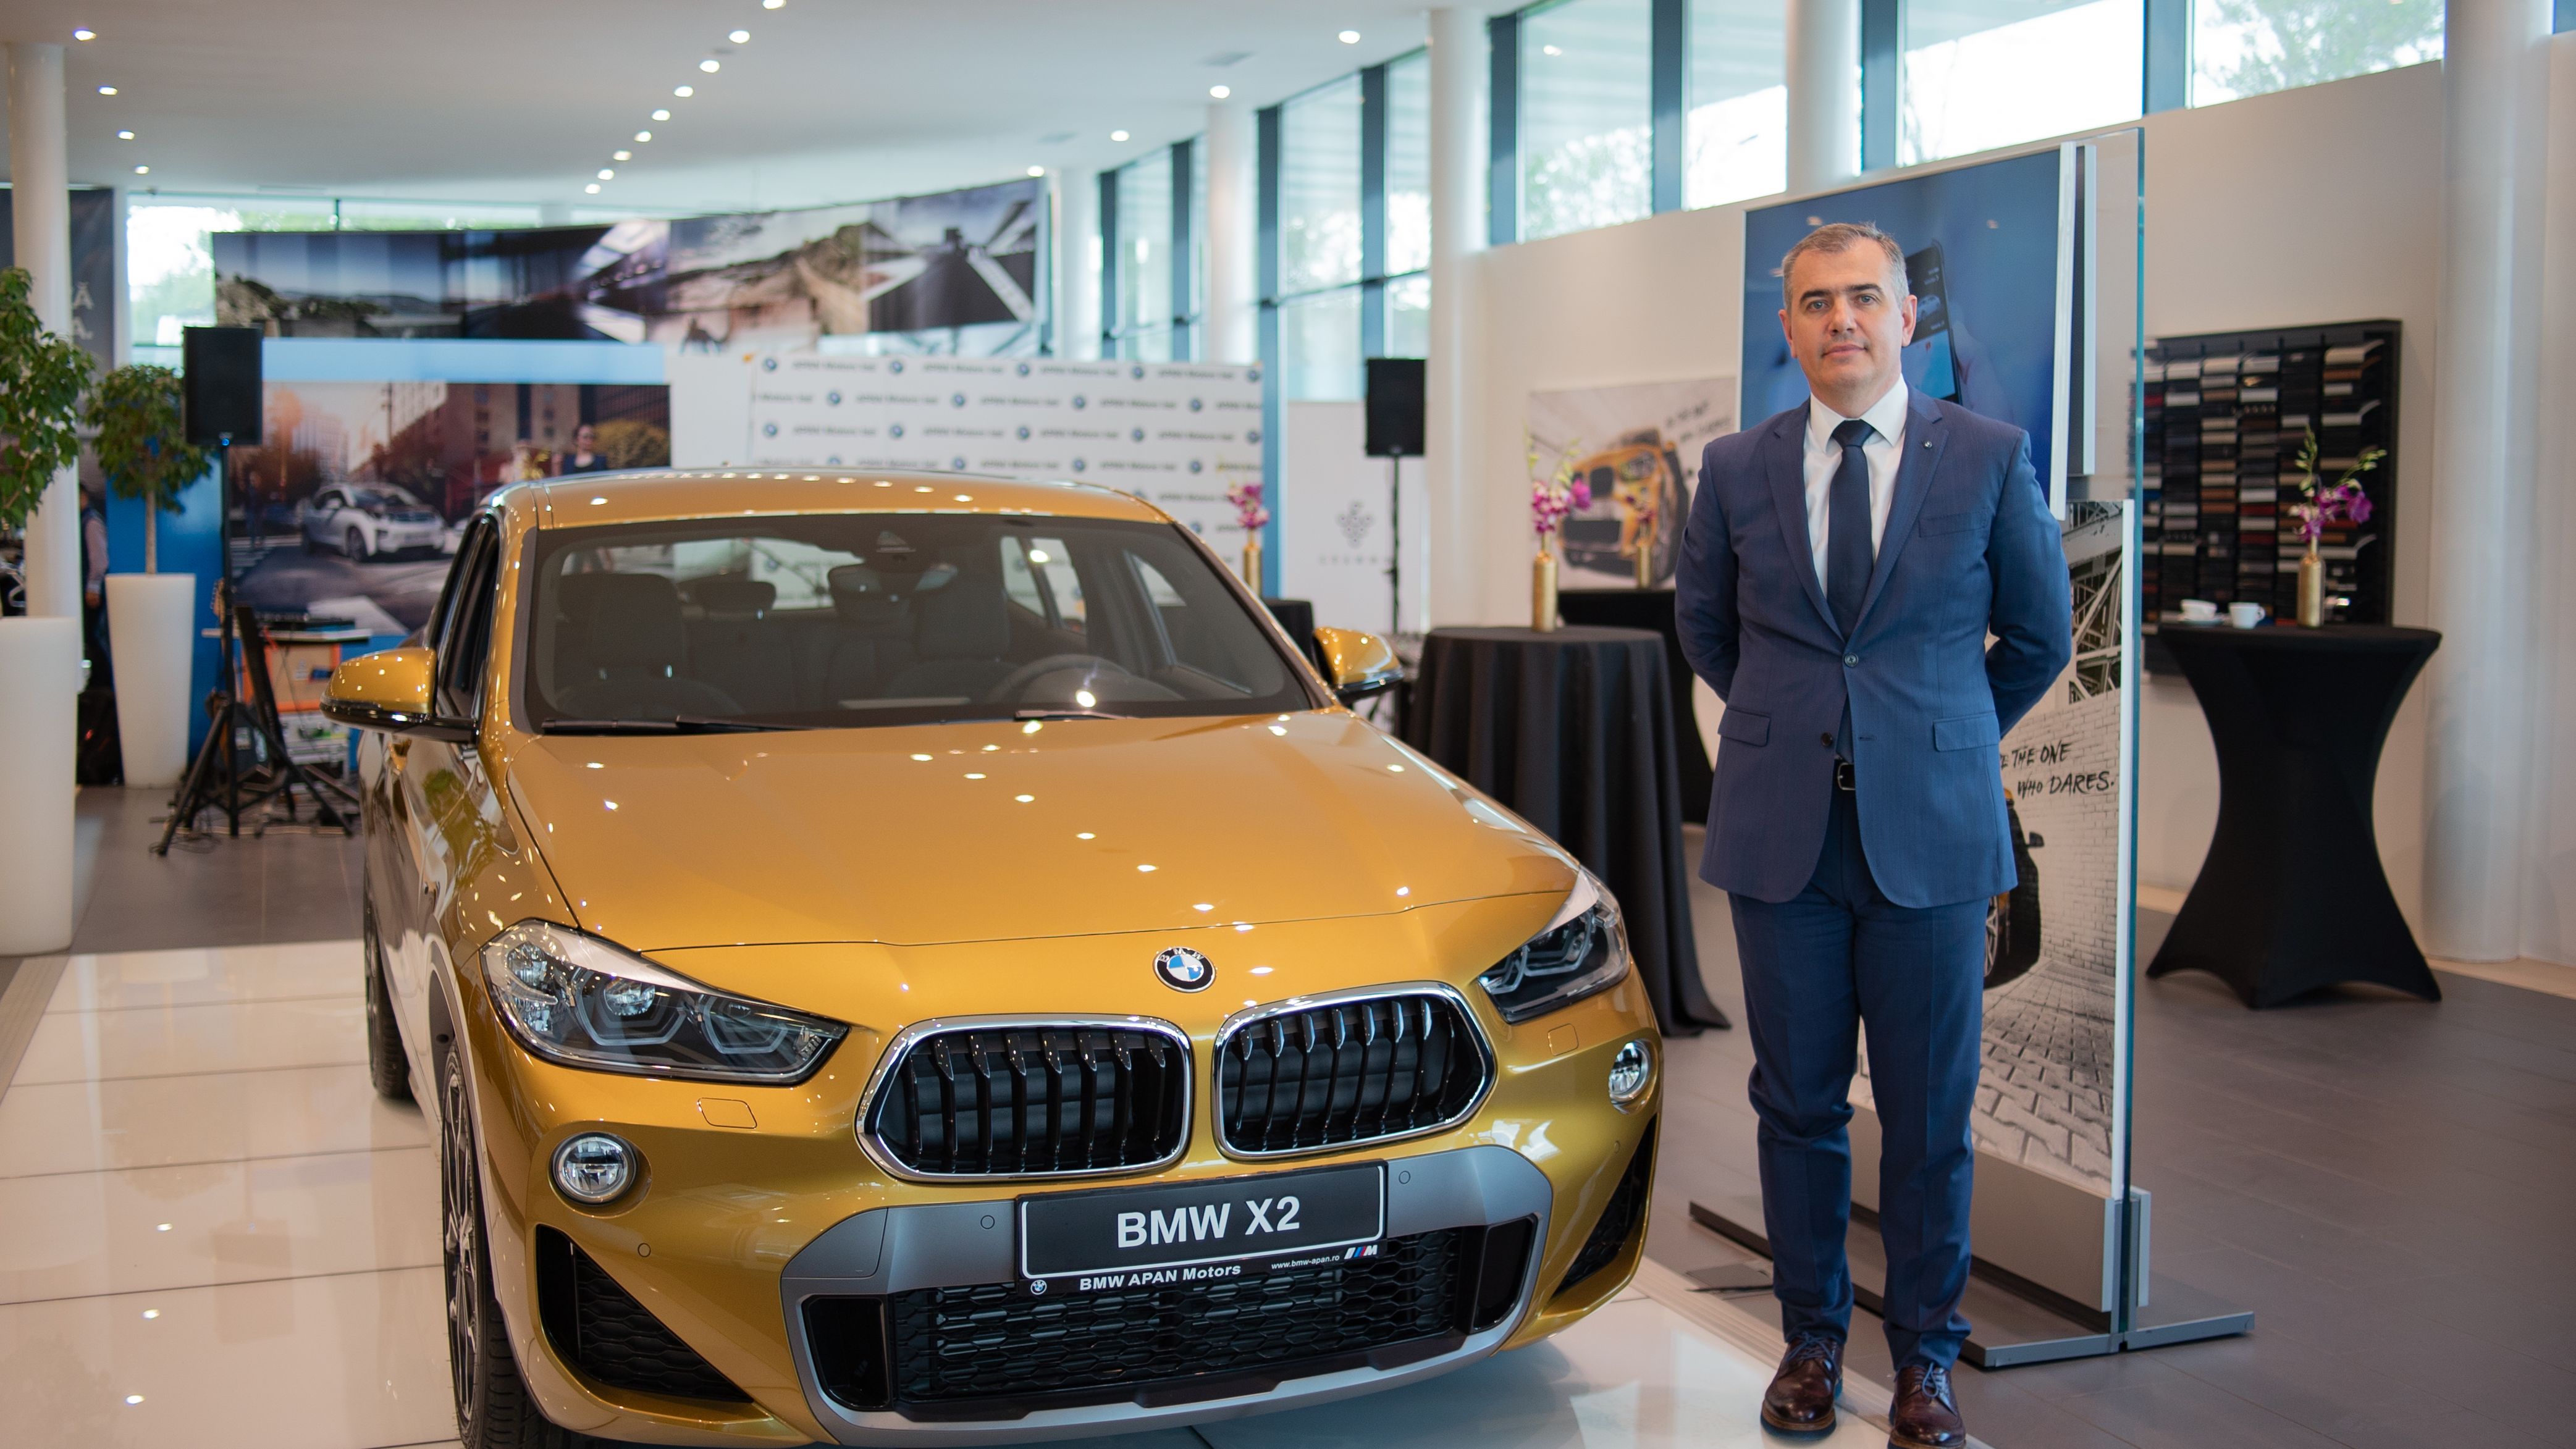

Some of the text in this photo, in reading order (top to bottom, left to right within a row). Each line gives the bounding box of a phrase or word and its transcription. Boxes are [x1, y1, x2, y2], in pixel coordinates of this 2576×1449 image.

[2012, 747, 2035, 768] THE
[2040, 741, 2072, 765] ONE
[2018, 771, 2115, 799] WHO DARES.
[1158, 947, 1204, 963] BMW
[1118, 1196, 1300, 1248] BMW X2
[1271, 1254, 1340, 1269] www.bmw-apan.ro
[1080, 1265, 1241, 1291] BMW APAN Motors
